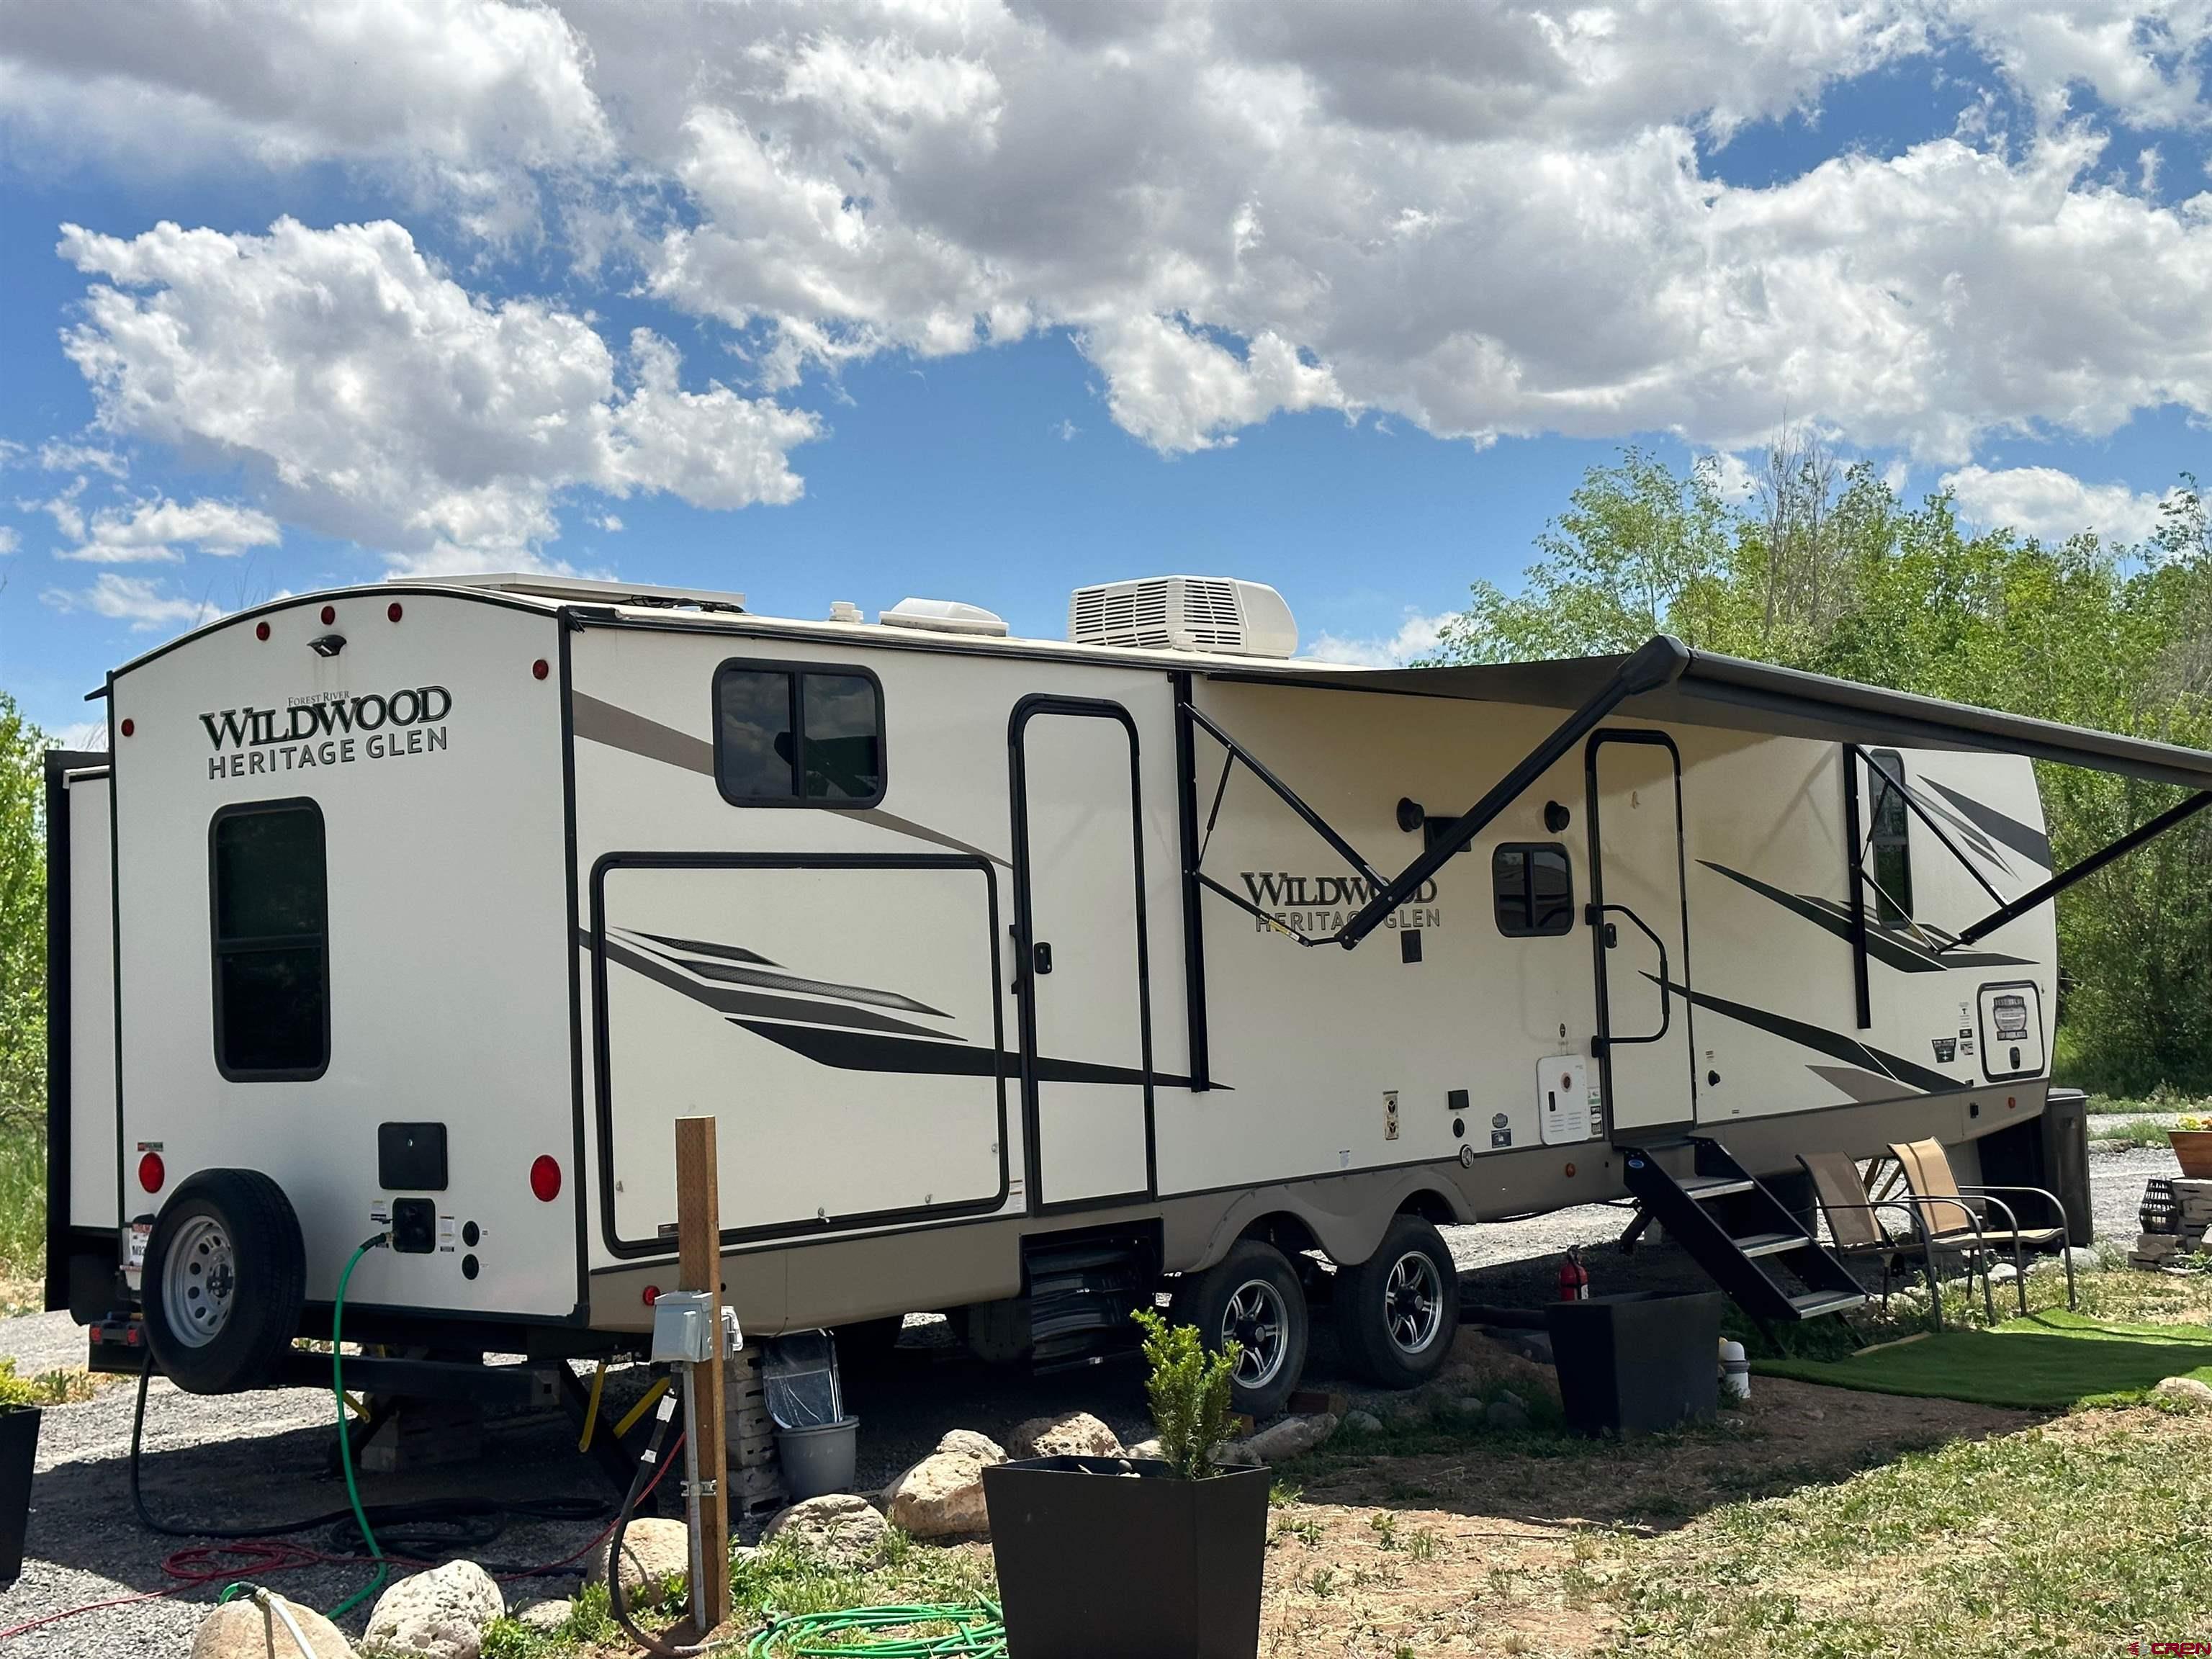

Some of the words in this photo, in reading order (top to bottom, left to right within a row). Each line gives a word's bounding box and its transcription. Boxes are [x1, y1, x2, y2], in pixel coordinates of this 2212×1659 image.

[288, 694, 321, 706] FOREST
[323, 691, 350, 702] RIVER
[199, 685, 452, 750] WILDWOOD
[209, 739, 355, 780] HERITAGE
[366, 727, 447, 759] GLEN
[1240, 872, 1437, 906] WILDWD
[1383, 908, 1440, 929] GLEN
